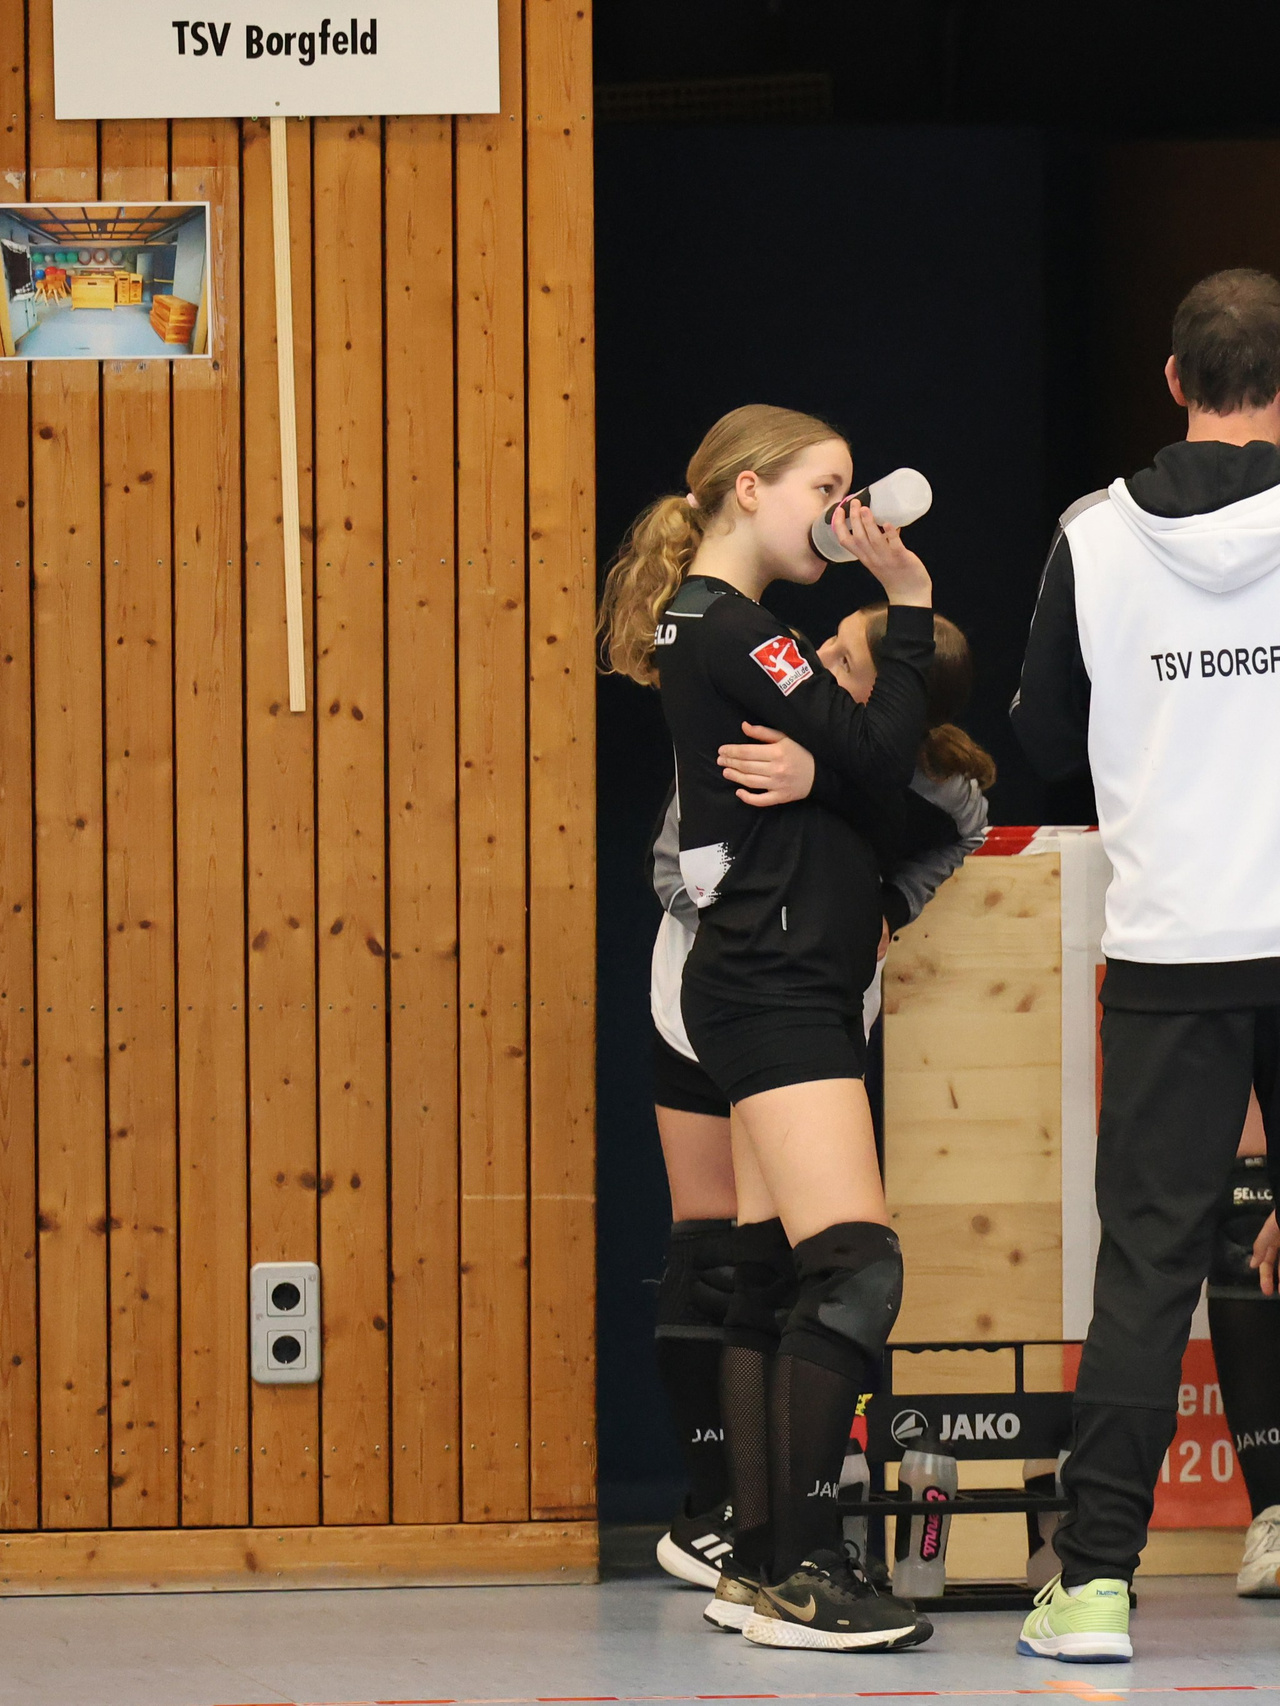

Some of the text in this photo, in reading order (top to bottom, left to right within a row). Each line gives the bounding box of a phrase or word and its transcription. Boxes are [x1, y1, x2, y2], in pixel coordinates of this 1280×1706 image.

[172, 18, 377, 66] TSV Borgfeld
[1151, 651, 1193, 682] TSV
[939, 1413, 1020, 1440] JAKO
[807, 1480, 839, 1499] JAK
